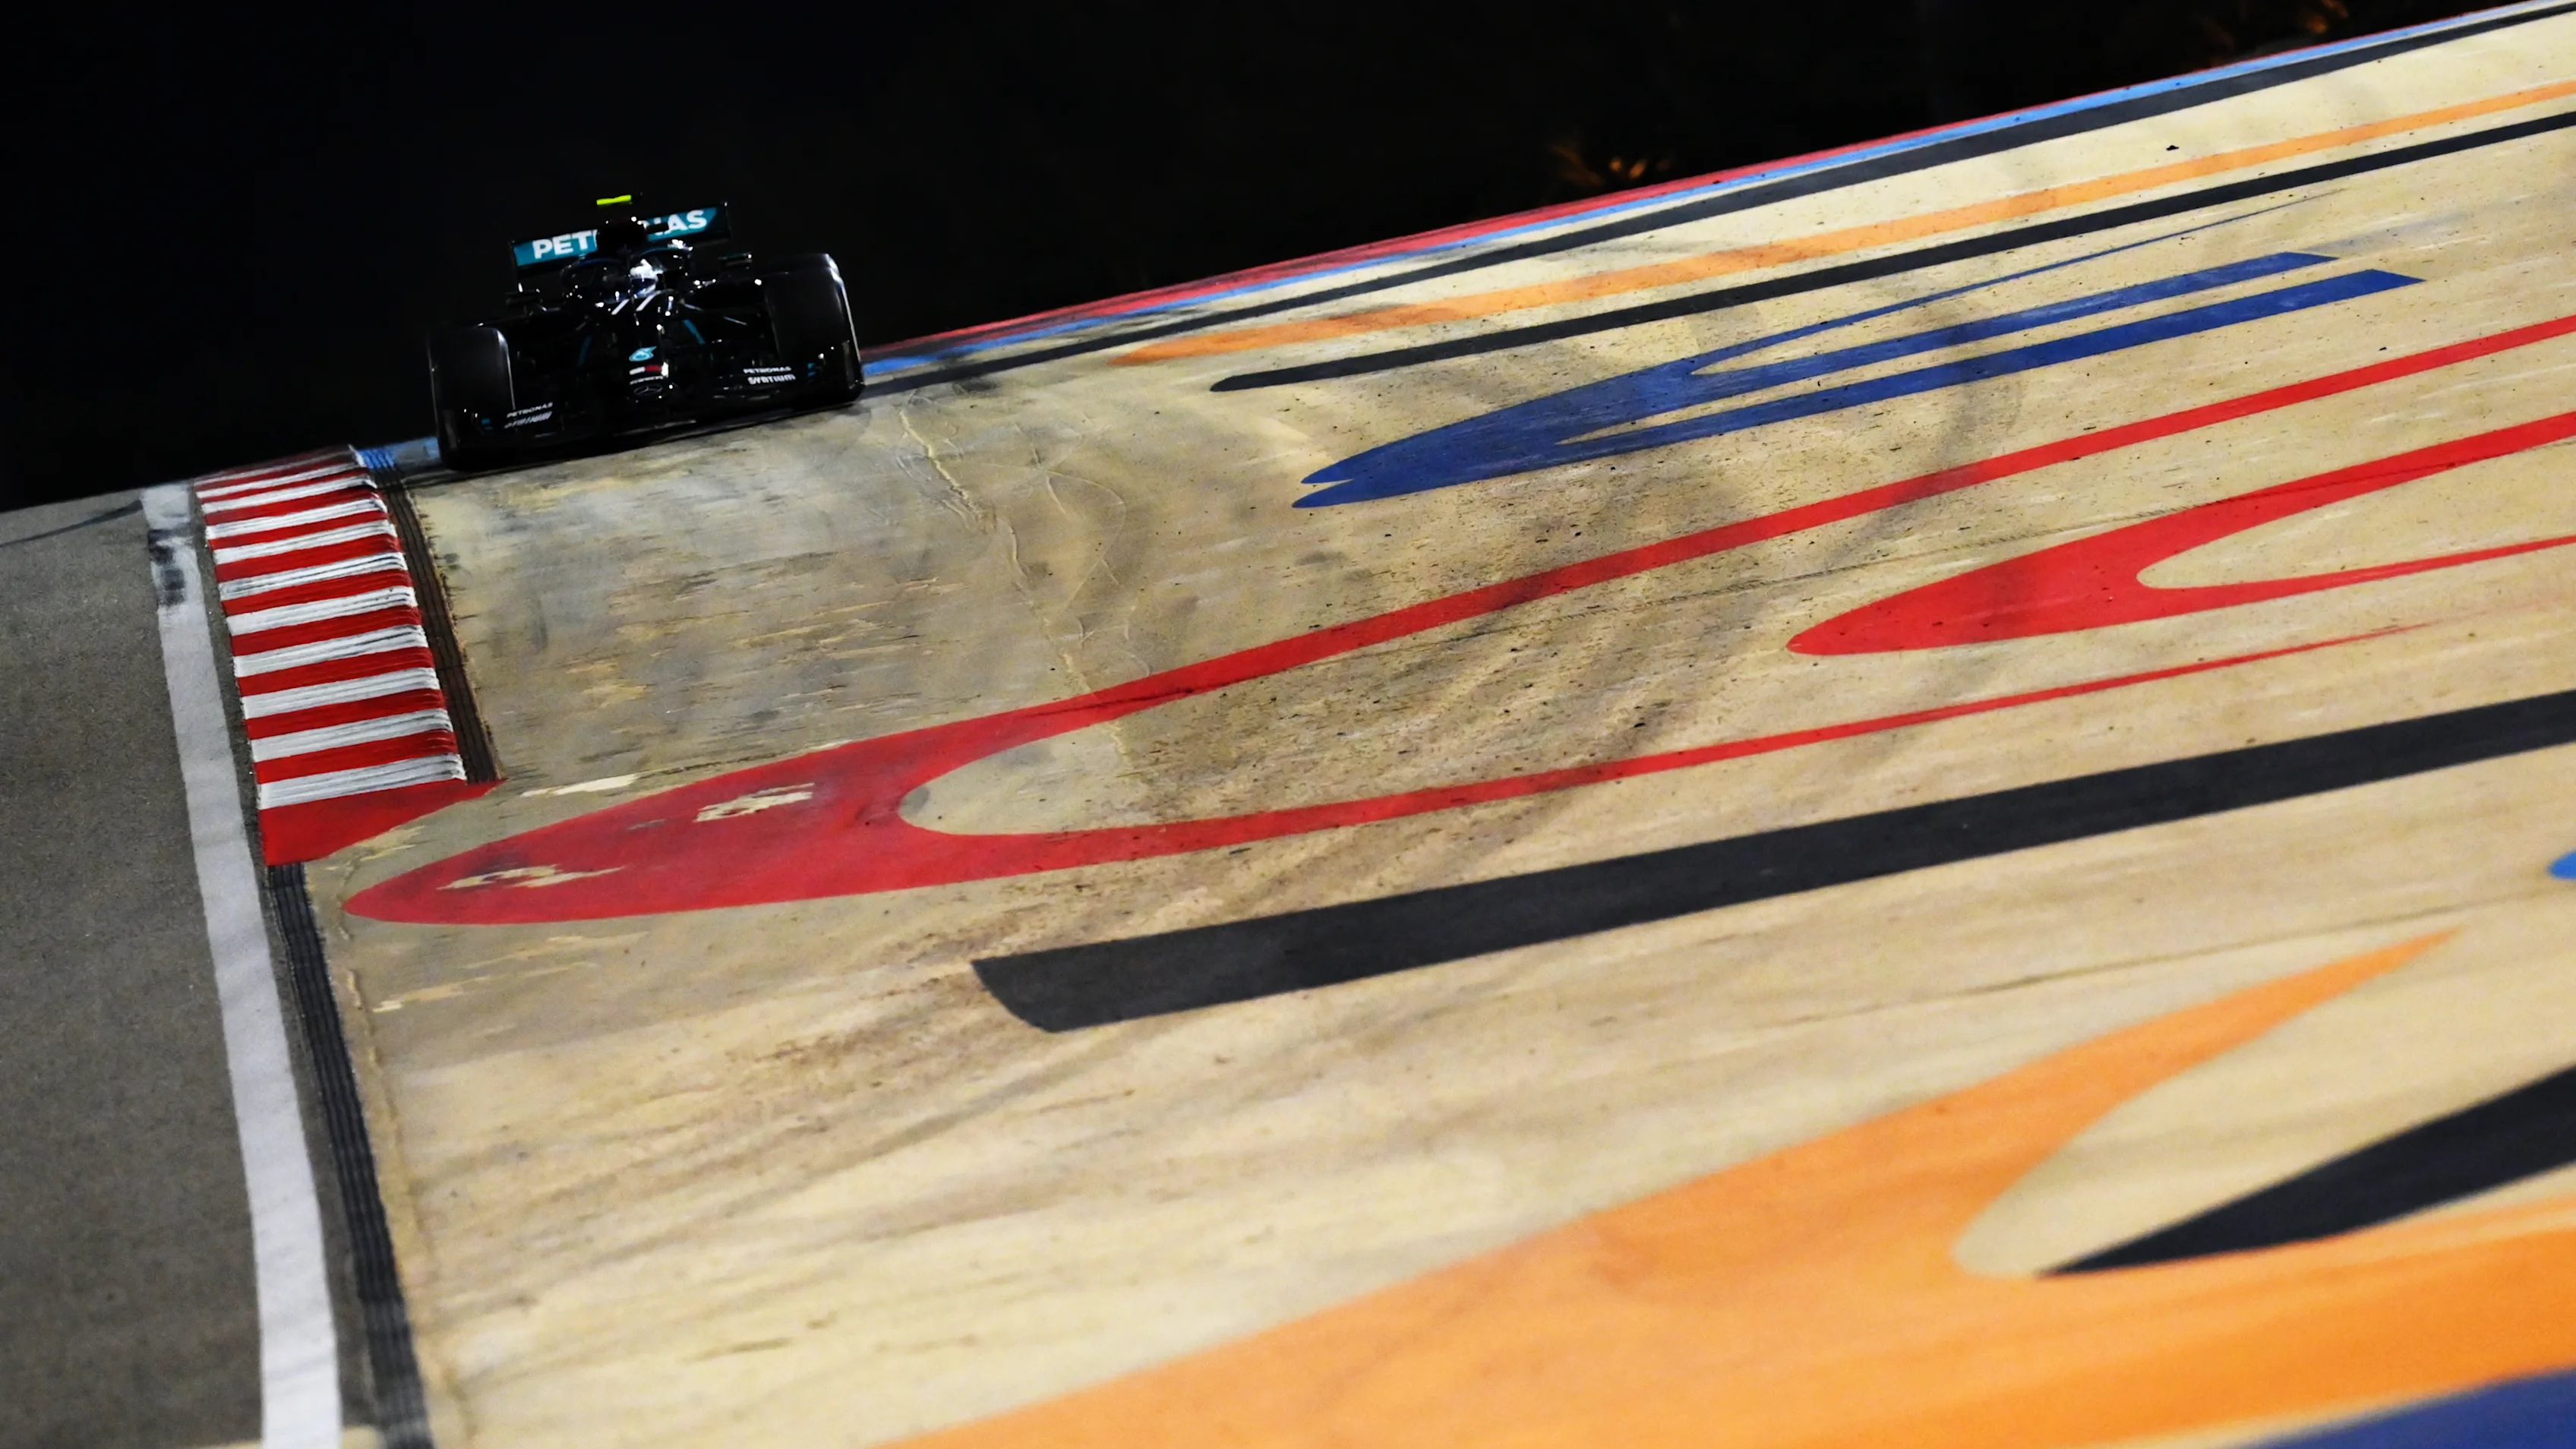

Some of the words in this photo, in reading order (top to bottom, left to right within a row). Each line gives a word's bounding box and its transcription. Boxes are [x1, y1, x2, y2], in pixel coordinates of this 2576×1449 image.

[532, 210, 708, 259] PETAS
[743, 366, 791, 374] PETRONAS
[507, 401, 554, 418] PETRONAS
